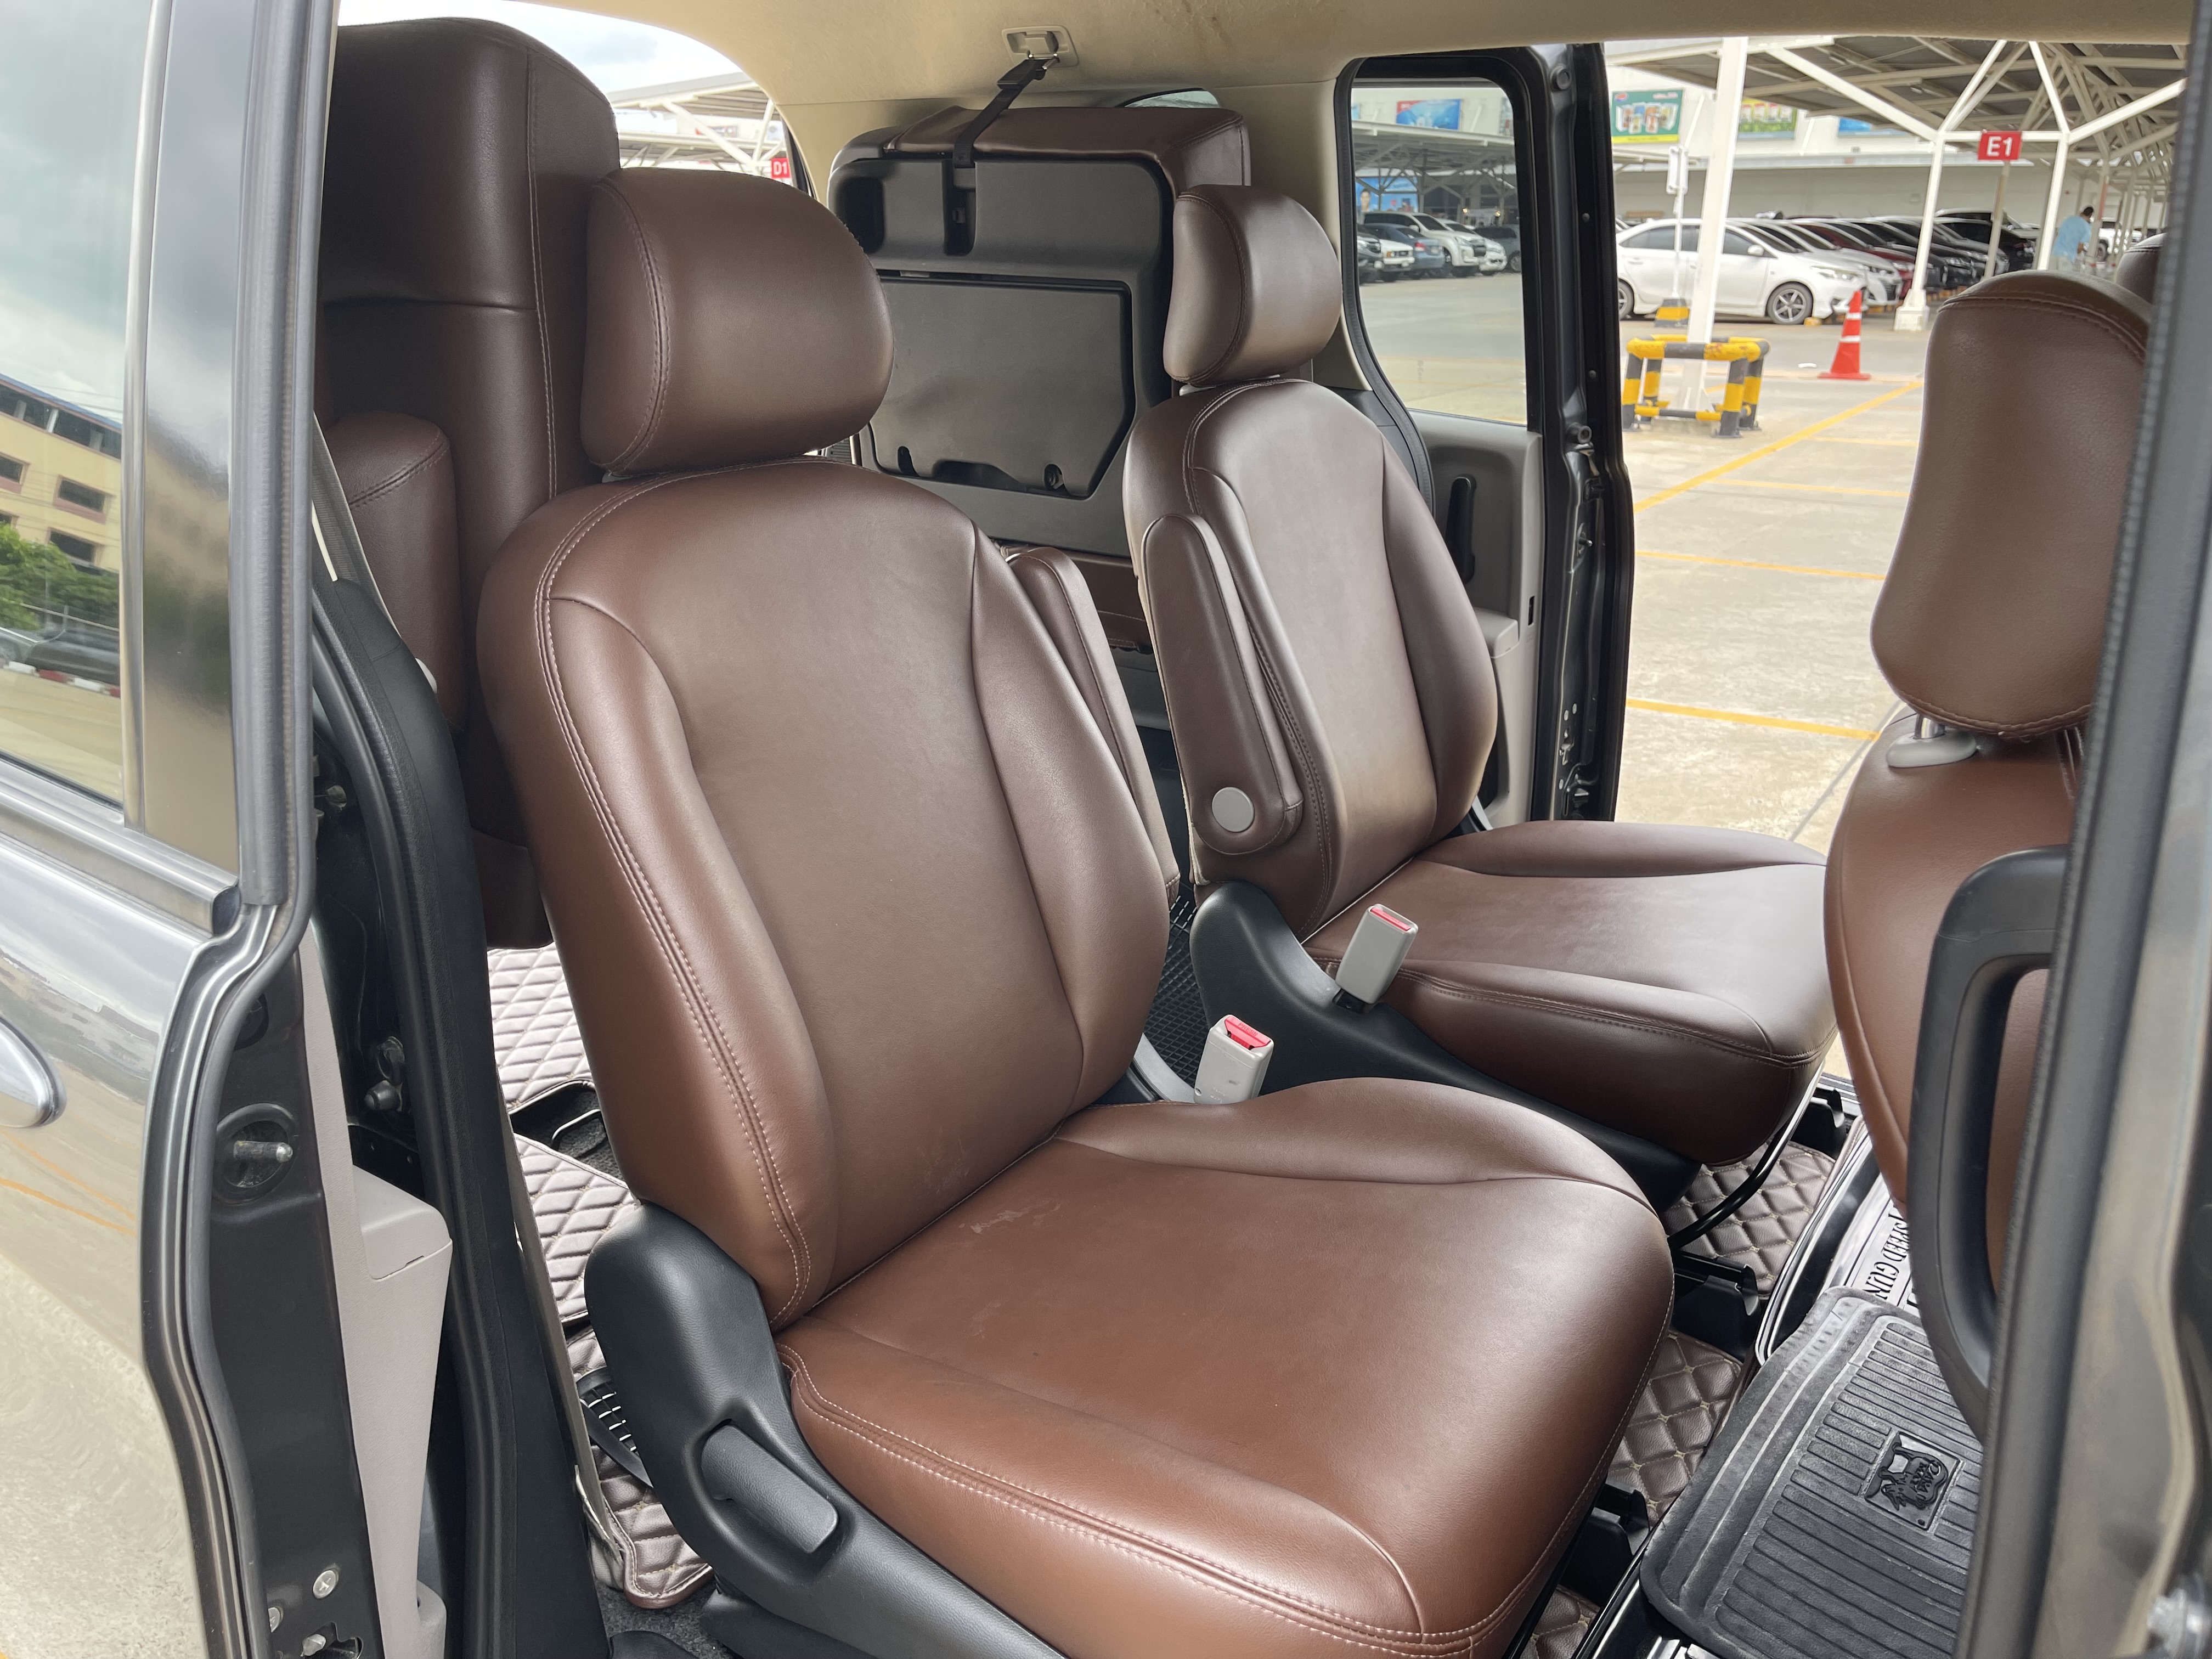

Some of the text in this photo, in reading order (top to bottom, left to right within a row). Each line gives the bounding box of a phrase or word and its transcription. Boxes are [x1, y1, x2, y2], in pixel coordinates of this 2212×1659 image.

[1986, 136, 2013, 157] E1
[774, 161, 788, 176] D1
[1238, 1023, 1259, 1036] PRESS
